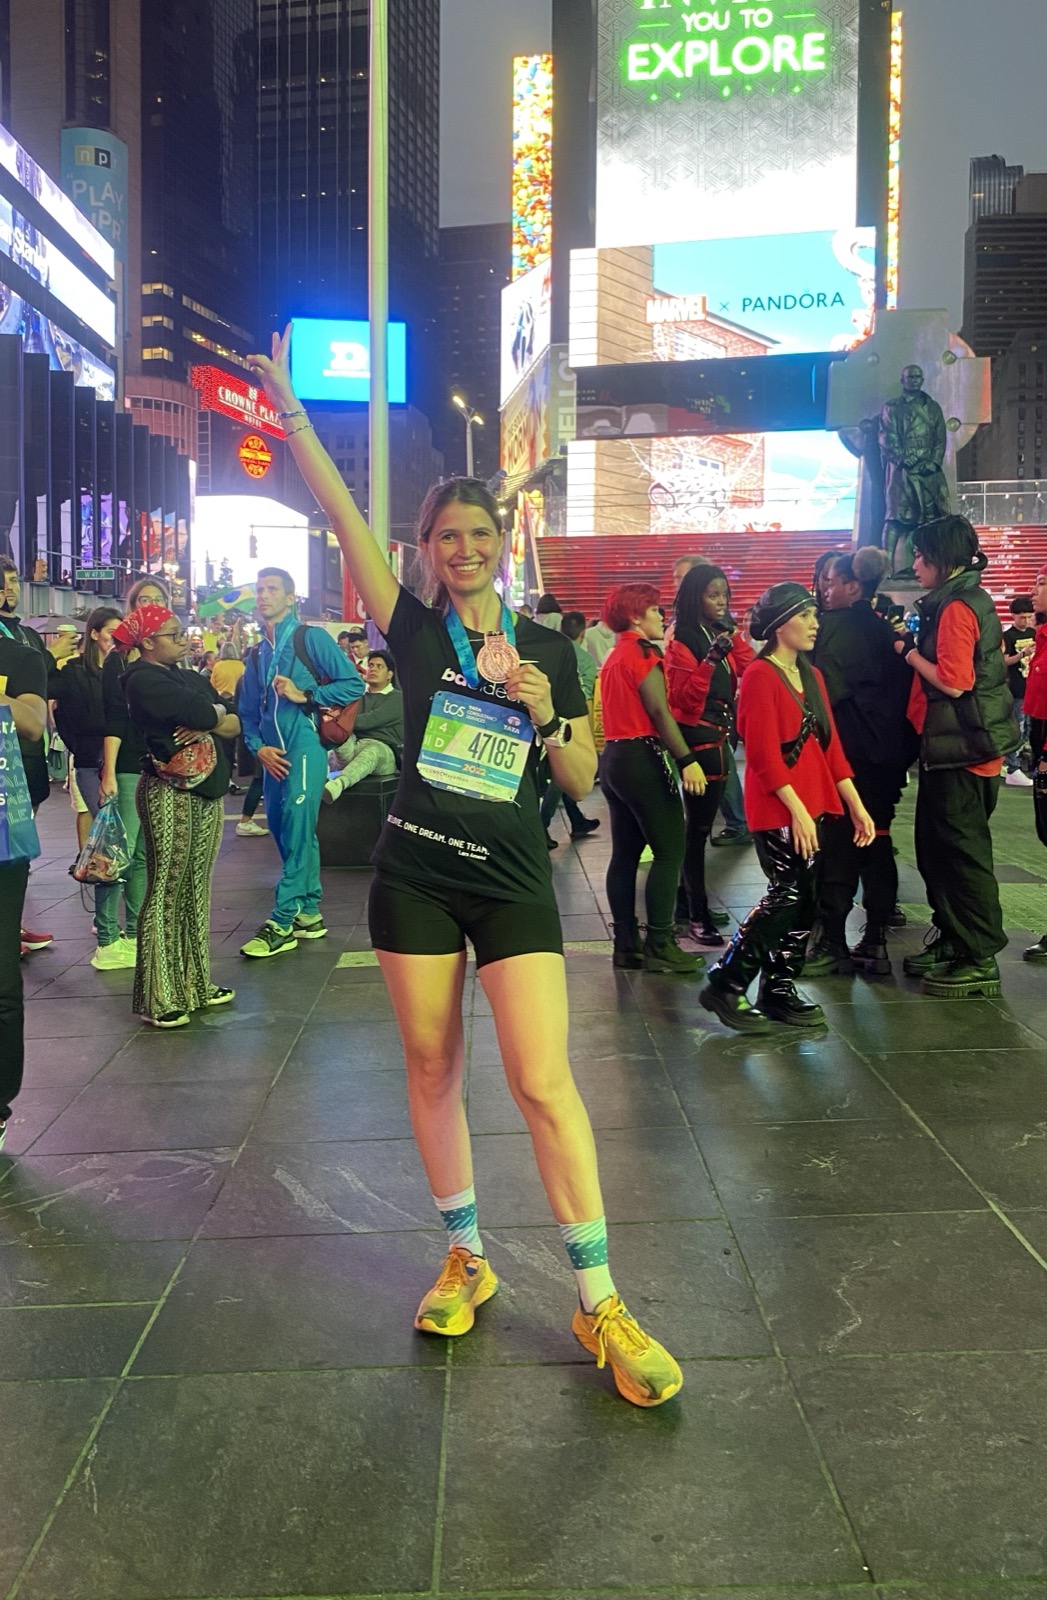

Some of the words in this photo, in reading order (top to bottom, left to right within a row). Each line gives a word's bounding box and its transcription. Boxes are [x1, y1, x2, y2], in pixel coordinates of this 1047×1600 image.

[681, 11, 730, 32] YOU
[739, 8, 773, 28] TO
[628, 33, 826, 80] EXPLORE
[741, 292, 845, 312] PANDORA
[217, 386, 257, 414] CROWNE
[259, 405, 282, 427] PLAZ
[244, 415, 262, 428] HOTEL
[443, 699, 466, 718] tcs
[439, 722, 448, 733] 4
[503, 724, 520, 735] TATA
[434, 737, 445, 748] D
[468, 732, 519, 769] 47185
[403, 822, 419, 834] ONE
[419, 827, 447, 844] DREAM.
[448, 837, 465, 849] ONE
[466, 842, 490, 855] TEAM.
